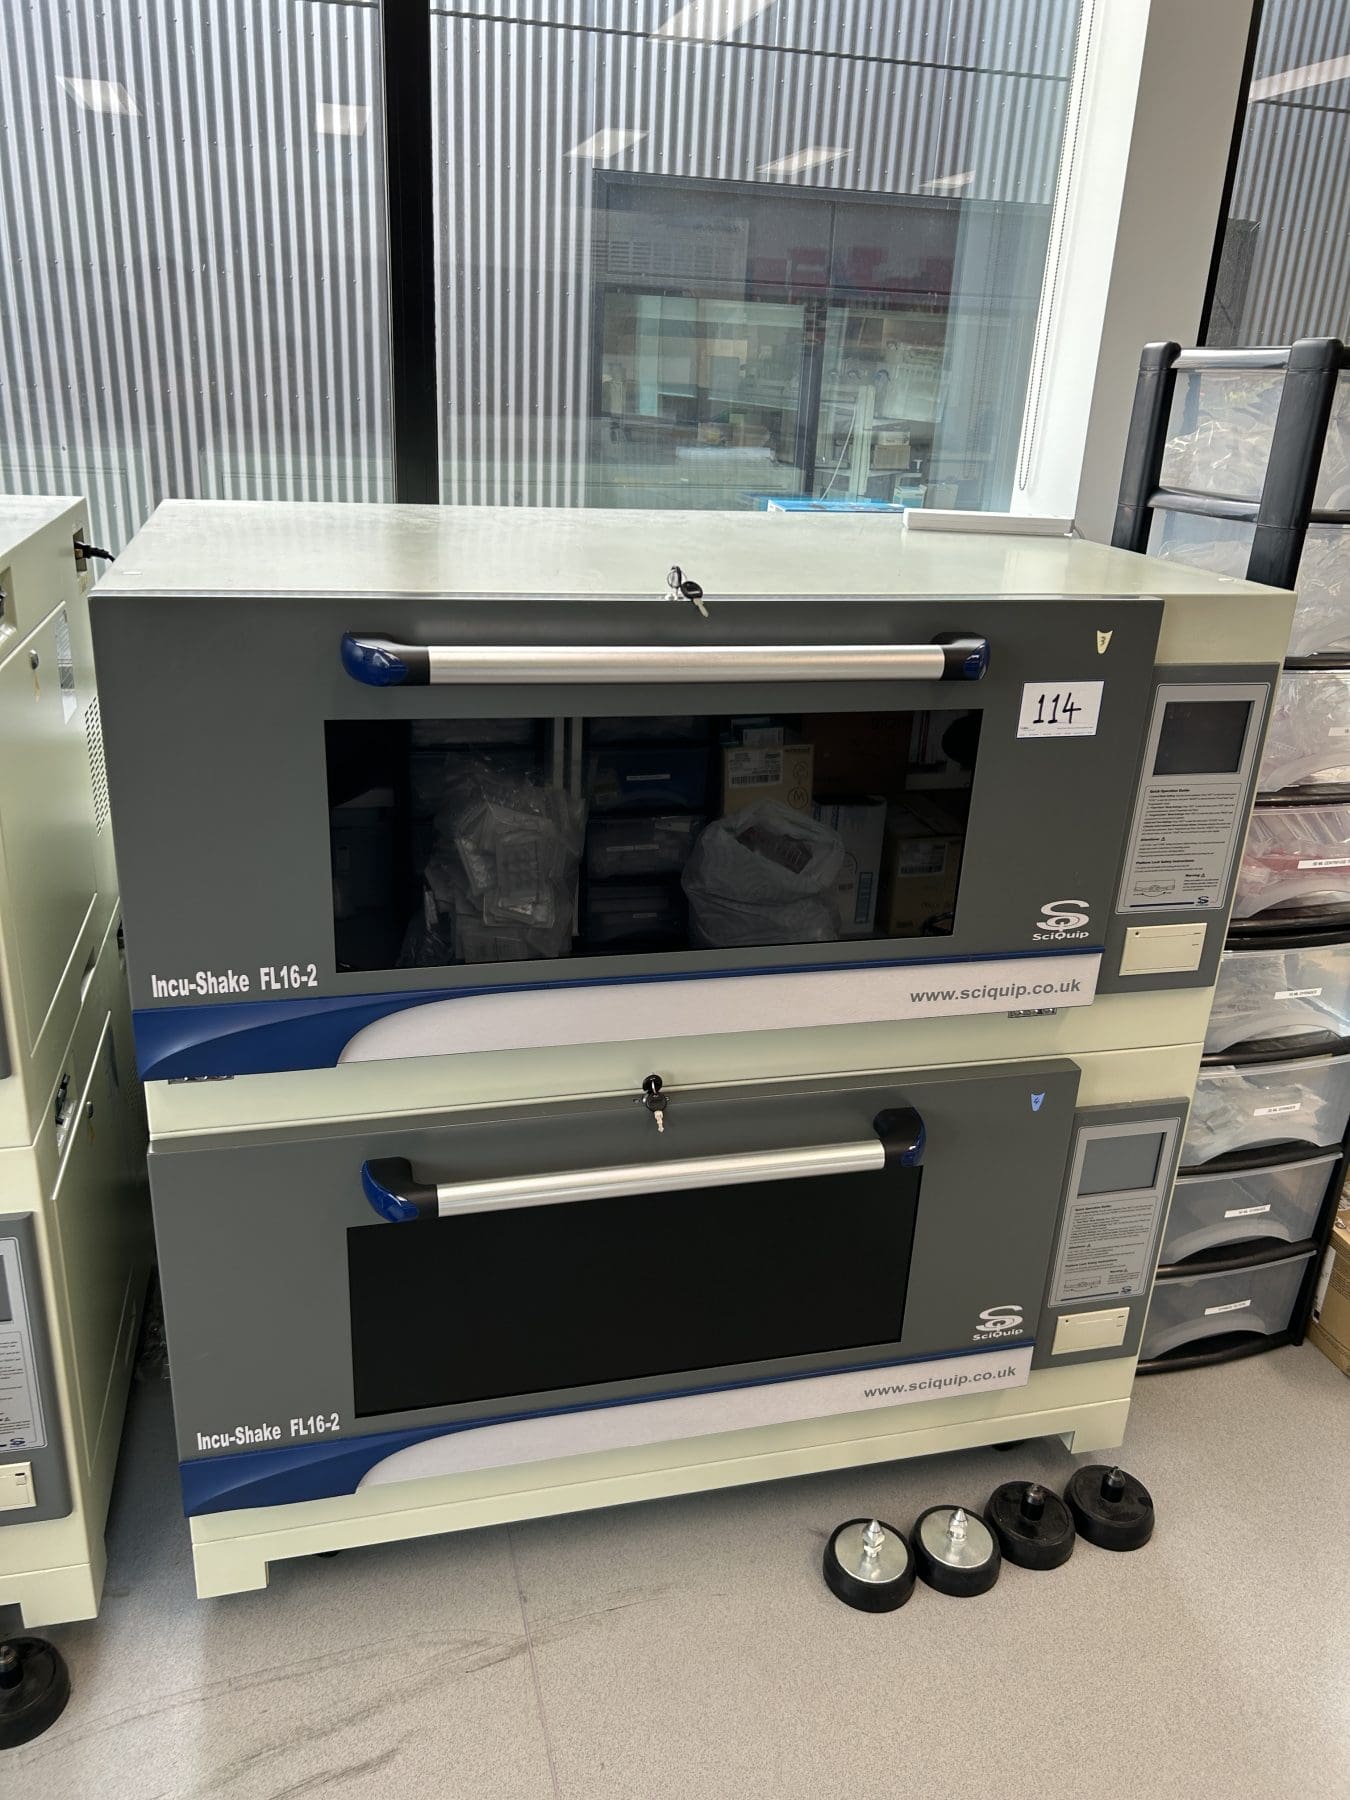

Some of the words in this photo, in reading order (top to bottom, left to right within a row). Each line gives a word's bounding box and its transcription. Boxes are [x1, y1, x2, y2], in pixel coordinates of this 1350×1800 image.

[1033, 692, 1082, 724] 114
[1032, 930, 1090, 941] SciQuip
[151, 969, 250, 998] Incu-Shake
[259, 963, 318, 991] FL16-2
[910, 978, 1081, 1003] www.sciquip.co.uk
[972, 1328, 1024, 1341] SciQuip
[864, 1366, 1016, 1398] www.sciquip.co.uk
[196, 1423, 282, 1451] Incu-Shake
[290, 1412, 341, 1437] FL16-2
